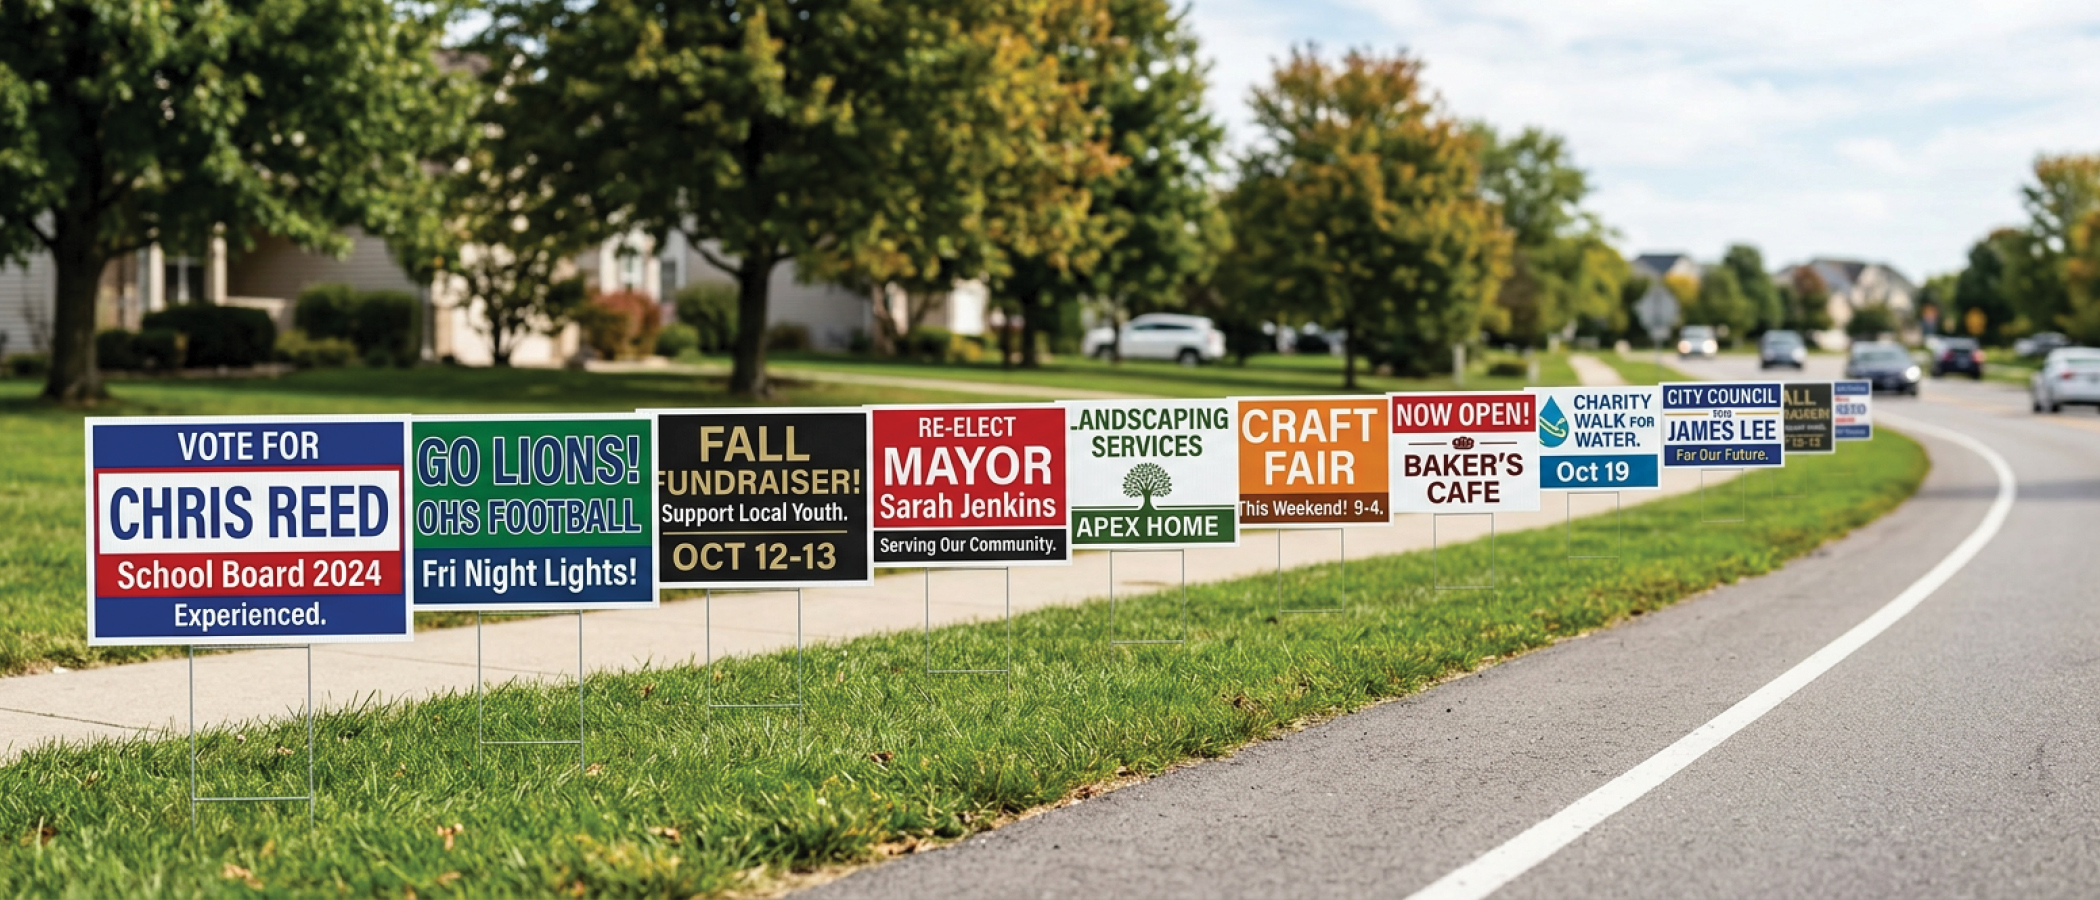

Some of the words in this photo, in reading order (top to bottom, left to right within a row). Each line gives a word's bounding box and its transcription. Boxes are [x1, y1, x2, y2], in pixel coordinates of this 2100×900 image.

[1574, 394, 1652, 410] CHARITY
[1668, 389, 1703, 405] CITY
[1708, 388, 1777, 404] COUNCIL
[1070, 408, 1229, 431] ANDSCAPING
[1242, 408, 1378, 444] CRAFT
[1397, 403, 1452, 427] NOW
[1459, 402, 1529, 426] OPEN!
[1574, 413, 1625, 428] WALK
[1630, 417, 1655, 427] FOR
[918, 417, 1016, 438] RE-ELECT
[1575, 432, 1641, 447] WATER.
[1668, 420, 1734, 441] JAMES
[1741, 420, 1776, 440] LEE
[177, 432, 253, 461] VOTE
[262, 431, 319, 460] FOR
[699, 425, 810, 462] FALL
[1091, 435, 1203, 457] SERVICES
[1700, 448, 1721, 460] Our
[1725, 448, 1769, 460] Future.
[416, 437, 481, 487] GO
[492, 435, 641, 486] LIONS!
[883, 446, 1052, 487] MAYOR
[1265, 450, 1355, 486] FAIR
[1404, 453, 1523, 477] BAKER'S
[1556, 461, 1598, 482] Oct
[1605, 461, 1629, 481] 19
[1427, 481, 1500, 503] CAFE
[109, 486, 254, 541] CHRIS
[269, 485, 389, 538] REED
[417, 500, 480, 536] OHS
[488, 499, 642, 536] FOOTBALL
[662, 505, 734, 527] Support
[739, 503, 787, 522] Local
[792, 503, 848, 522] Youth.
[880, 494, 954, 520] Sarah
[960, 492, 1057, 519] Jenkins
[1239, 500, 1269, 516] This
[1273, 500, 1347, 516] Weekend!
[1354, 500, 1383, 515] 9-4.
[1076, 517, 1140, 538] APEX
[1147, 516, 1218, 537] HOME
[673, 543, 745, 571] OCT
[755, 543, 837, 570] 12-13
[880, 537, 937, 557] Serving
[941, 537, 967, 553] Our
[970, 536, 1057, 556] Community.
[116, 560, 214, 590] School
[222, 559, 305, 589] Board
[312, 559, 382, 587] 2024
[422, 559, 458, 588] Fri
[464, 558, 537, 594] Night
[543, 557, 638, 593] Lights!
[174, 601, 327, 632] Experienced.
